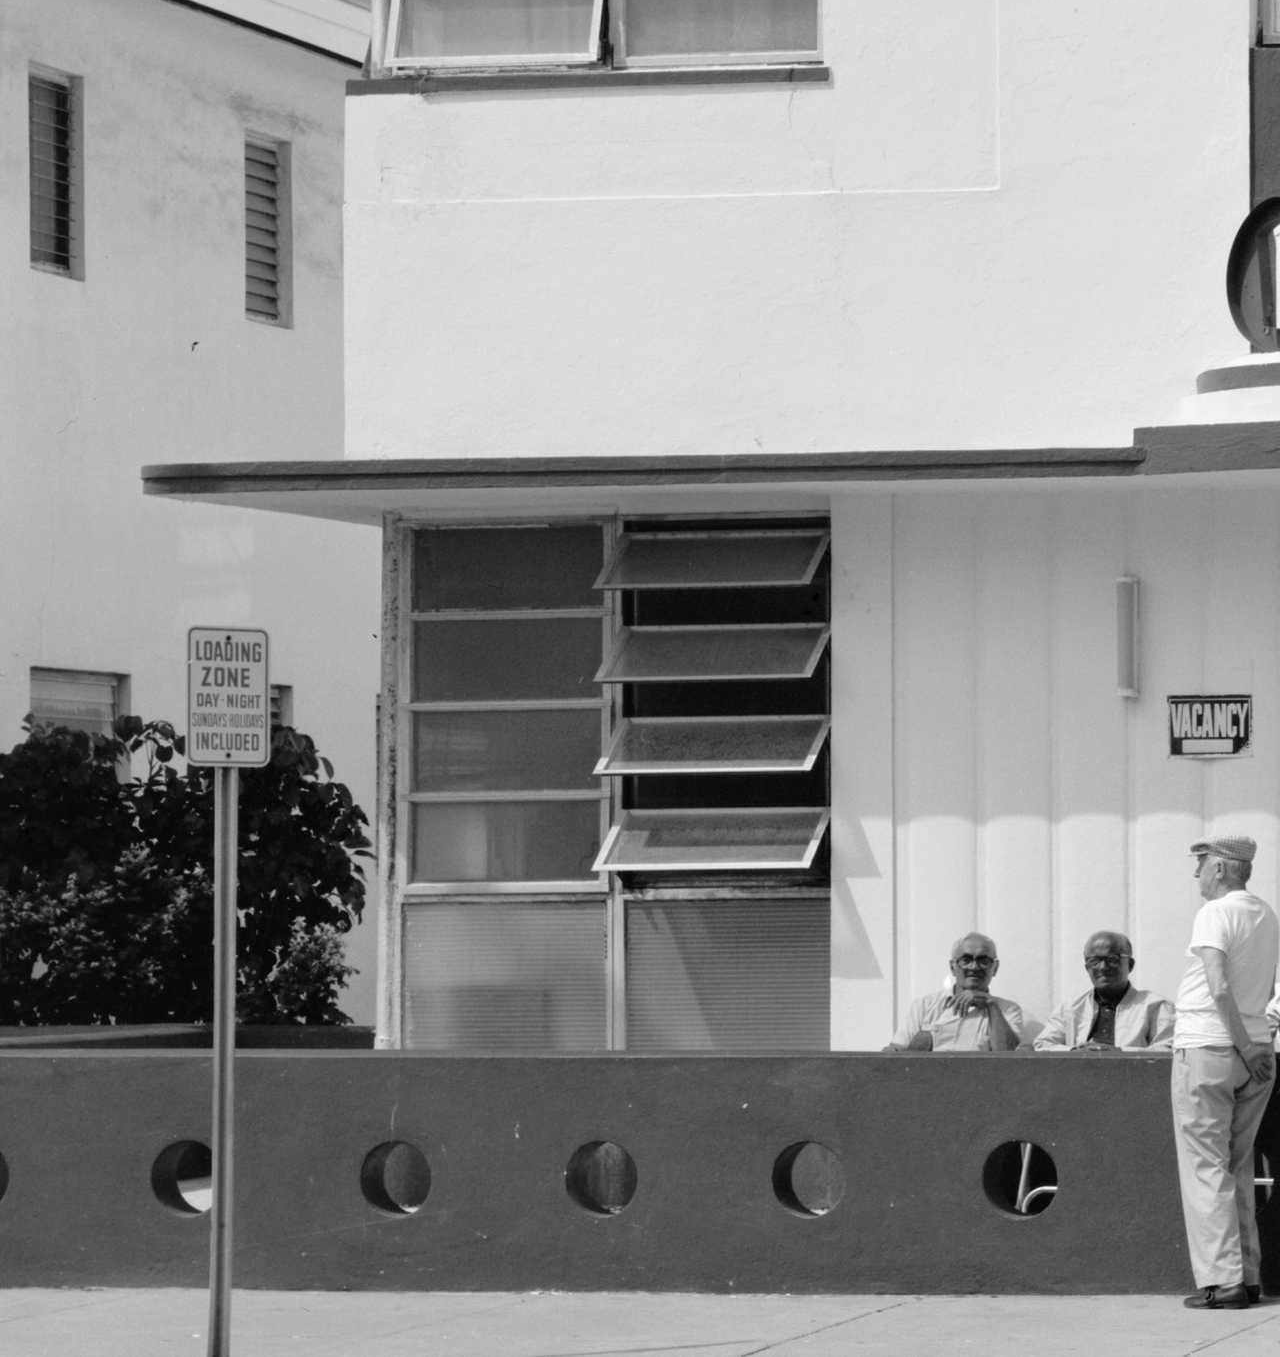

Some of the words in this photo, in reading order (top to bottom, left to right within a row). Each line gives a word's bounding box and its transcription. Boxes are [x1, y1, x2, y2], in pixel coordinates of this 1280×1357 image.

[195, 640, 262, 663] LOADING
[201, 666, 251, 688] ZONE
[1169, 703, 1249, 739] VACANCY
[196, 732, 260, 752] INCLUDED
